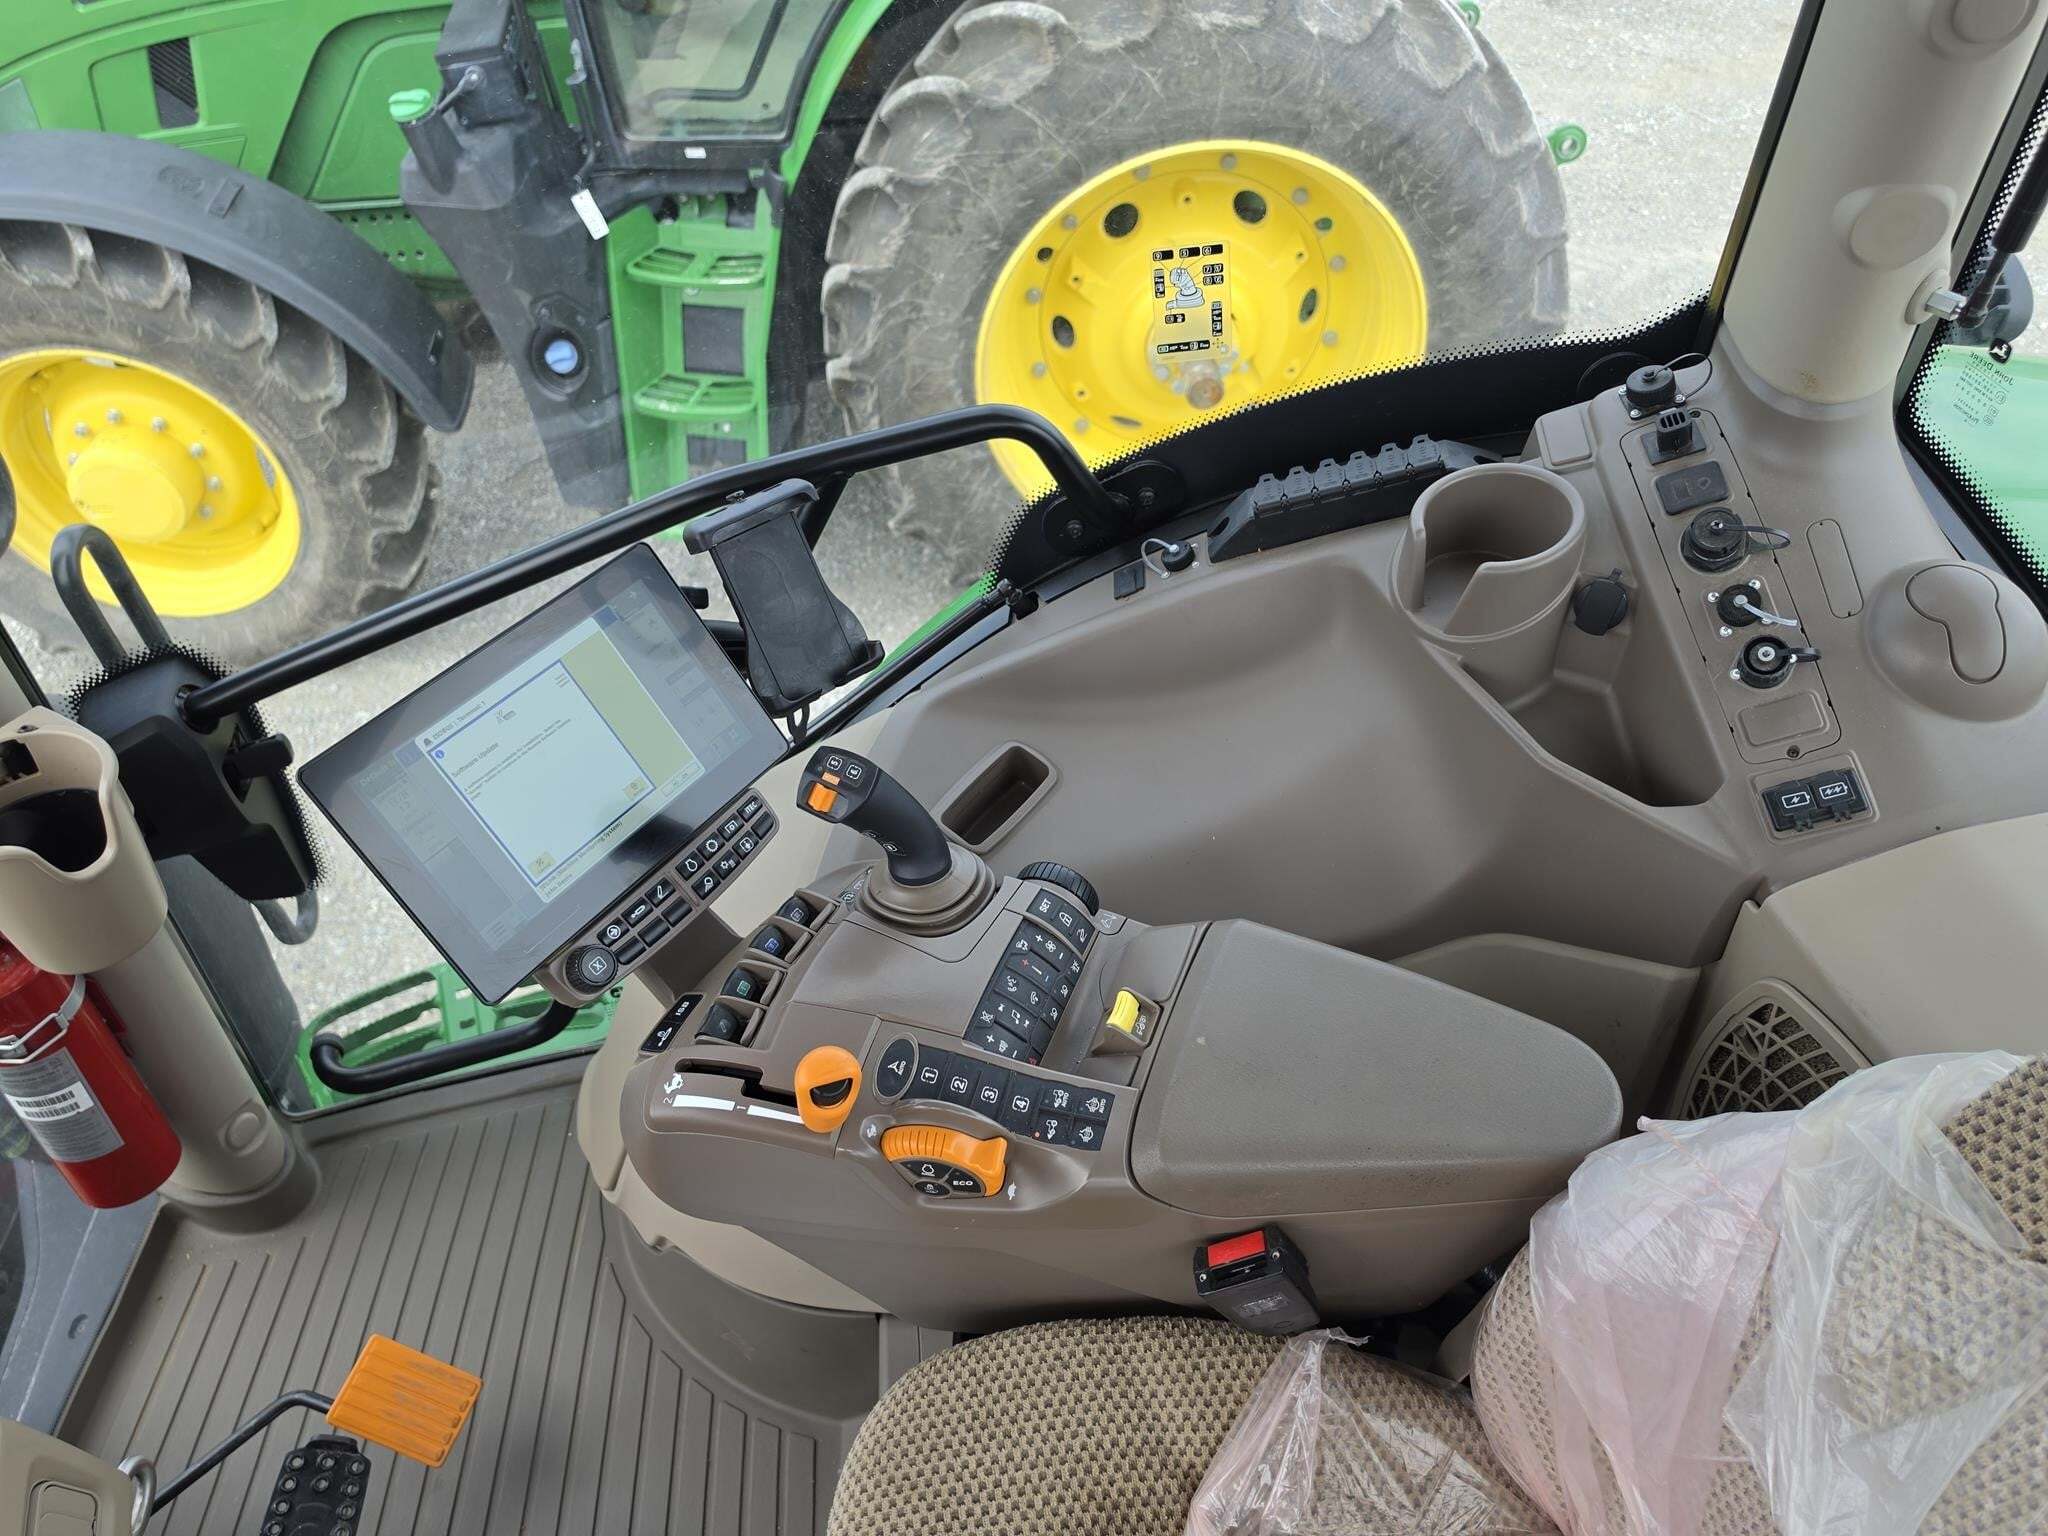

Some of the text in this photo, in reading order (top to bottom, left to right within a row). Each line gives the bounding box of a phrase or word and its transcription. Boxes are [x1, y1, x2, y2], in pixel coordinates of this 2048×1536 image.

[1039, 898, 1052, 912] SET
[898, 1060, 906, 1076] AUTO
[953, 1080, 965, 1090] 2
[984, 1090, 995, 1099] 3
[1061, 1092, 1069, 1108] AUTO
[1015, 1100, 1027, 1109] 4
[1098, 1098, 1106, 1114] AUTO
